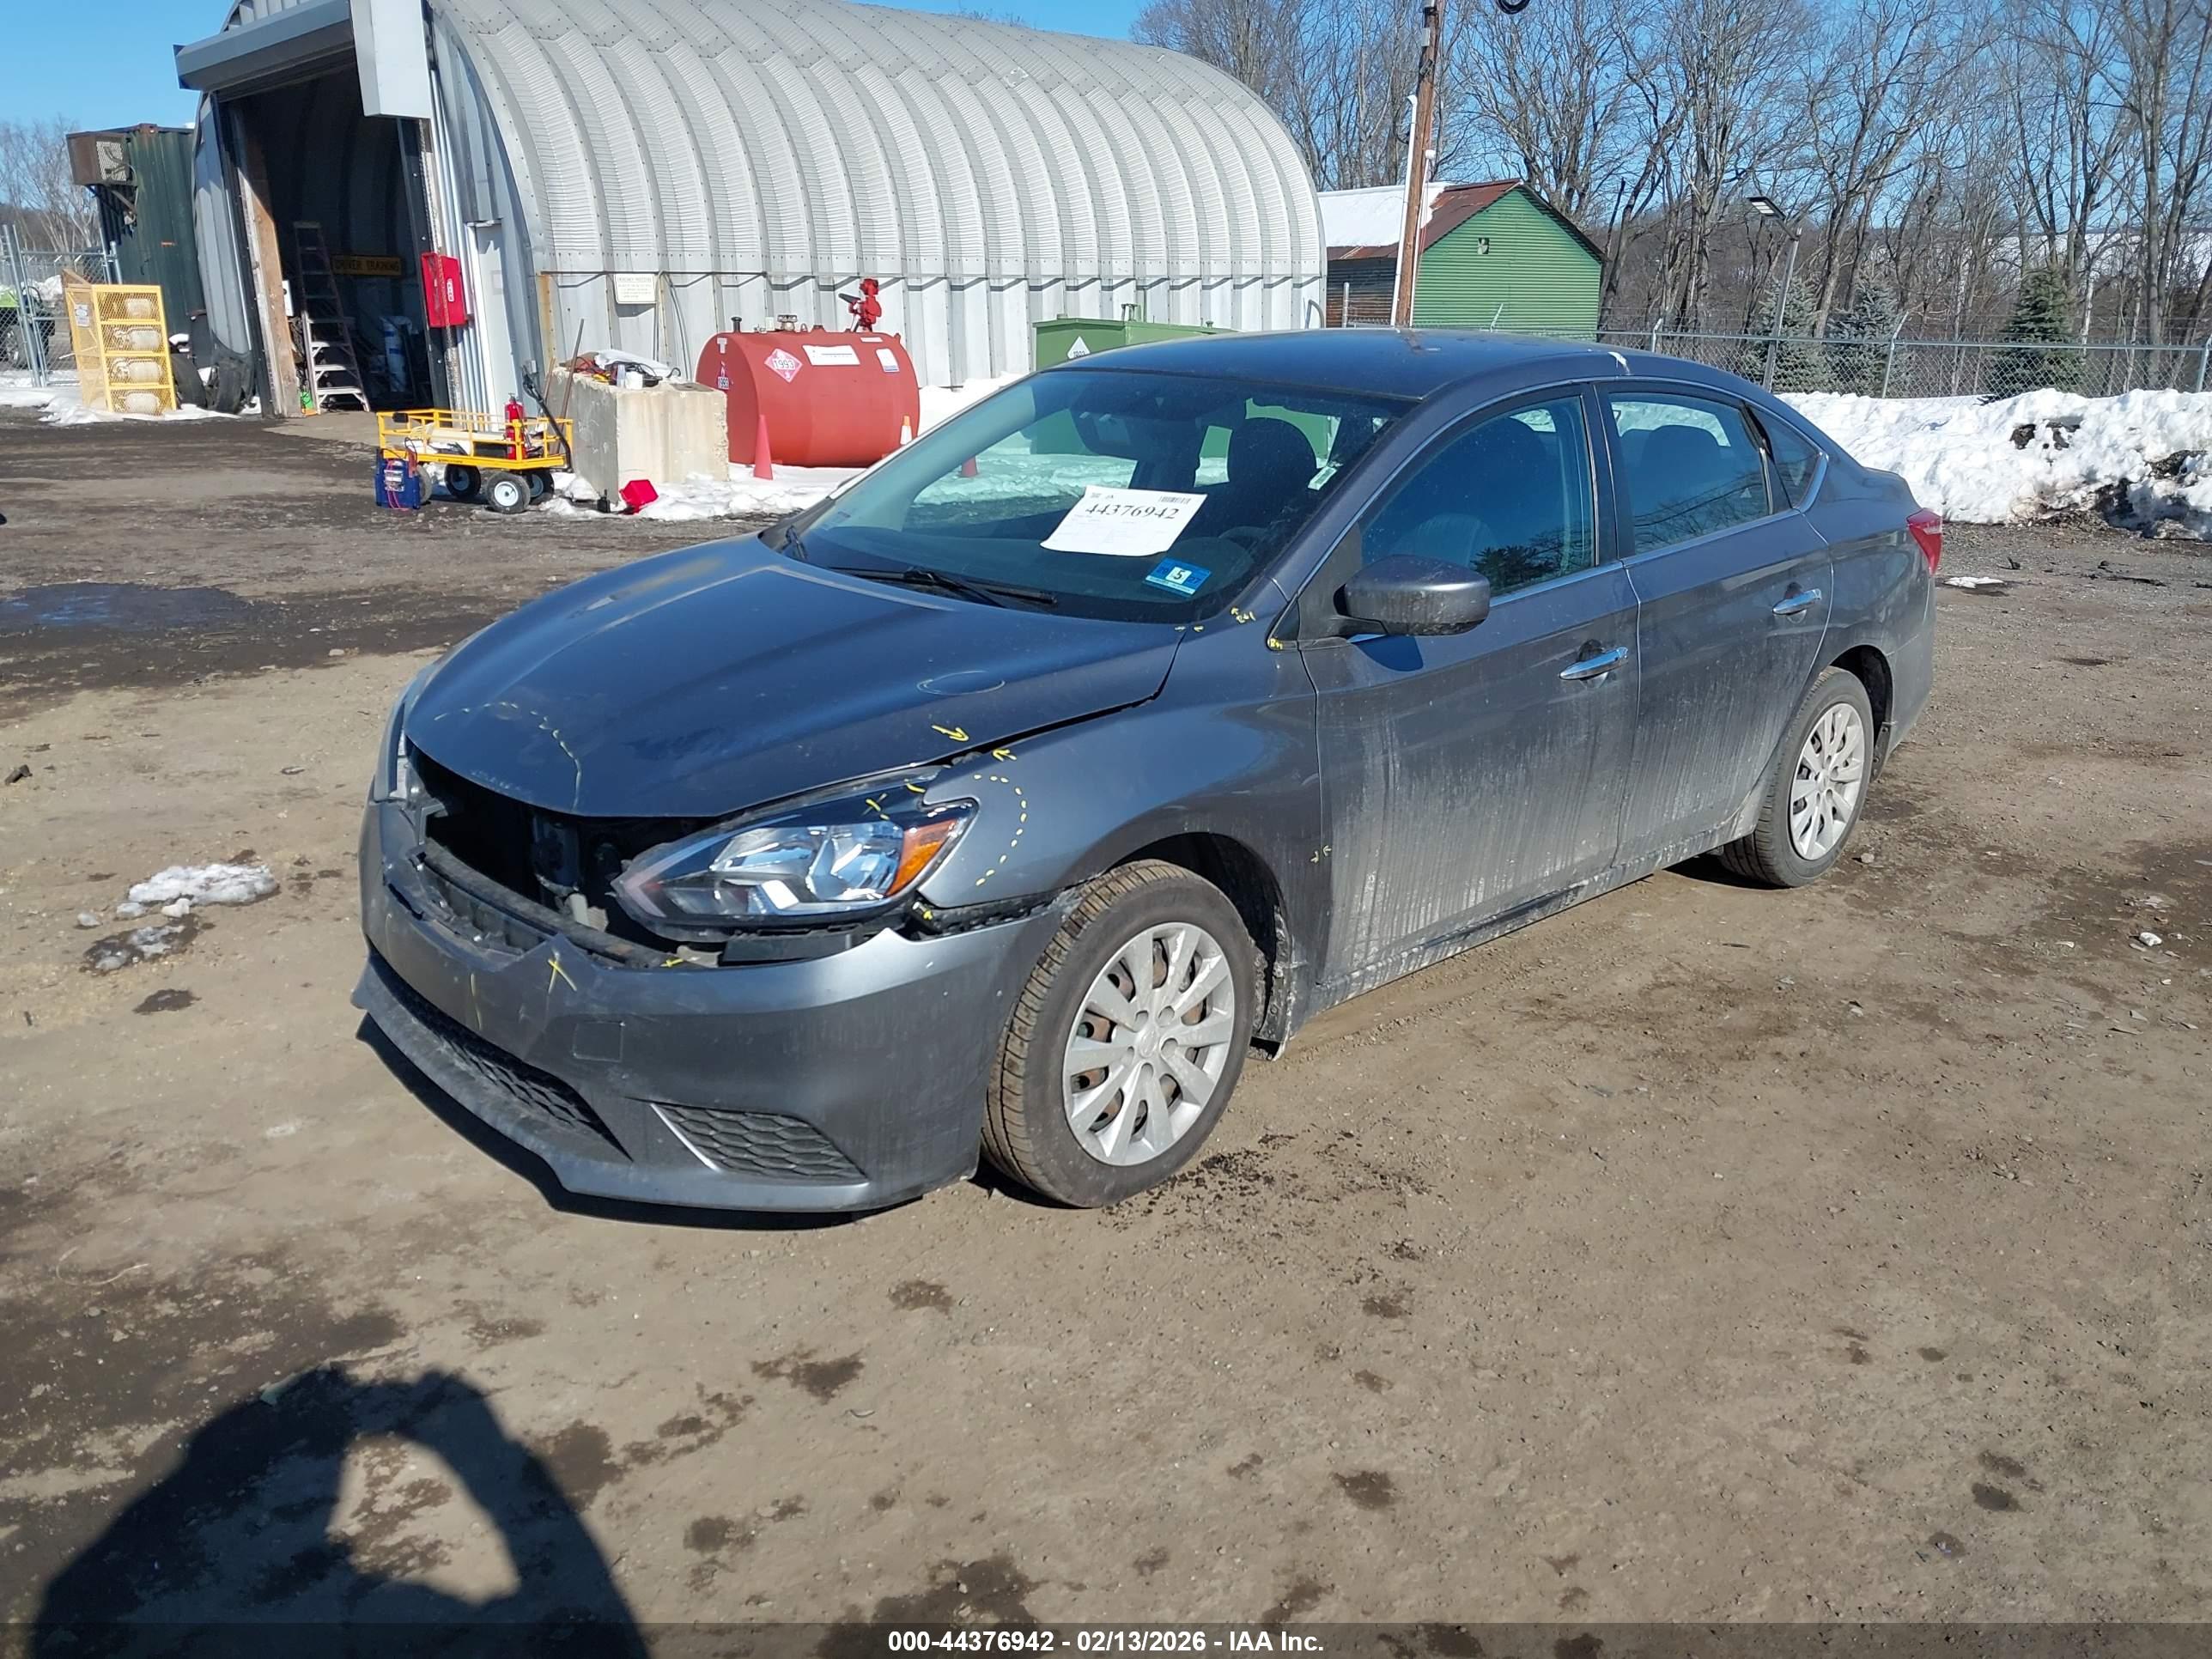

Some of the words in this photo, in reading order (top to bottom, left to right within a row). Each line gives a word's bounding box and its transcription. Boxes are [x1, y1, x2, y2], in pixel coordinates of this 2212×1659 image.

[774, 359, 794, 369] 1993
[1085, 503, 1180, 520] 44376942
[1173, 569, 1185, 580] 5
